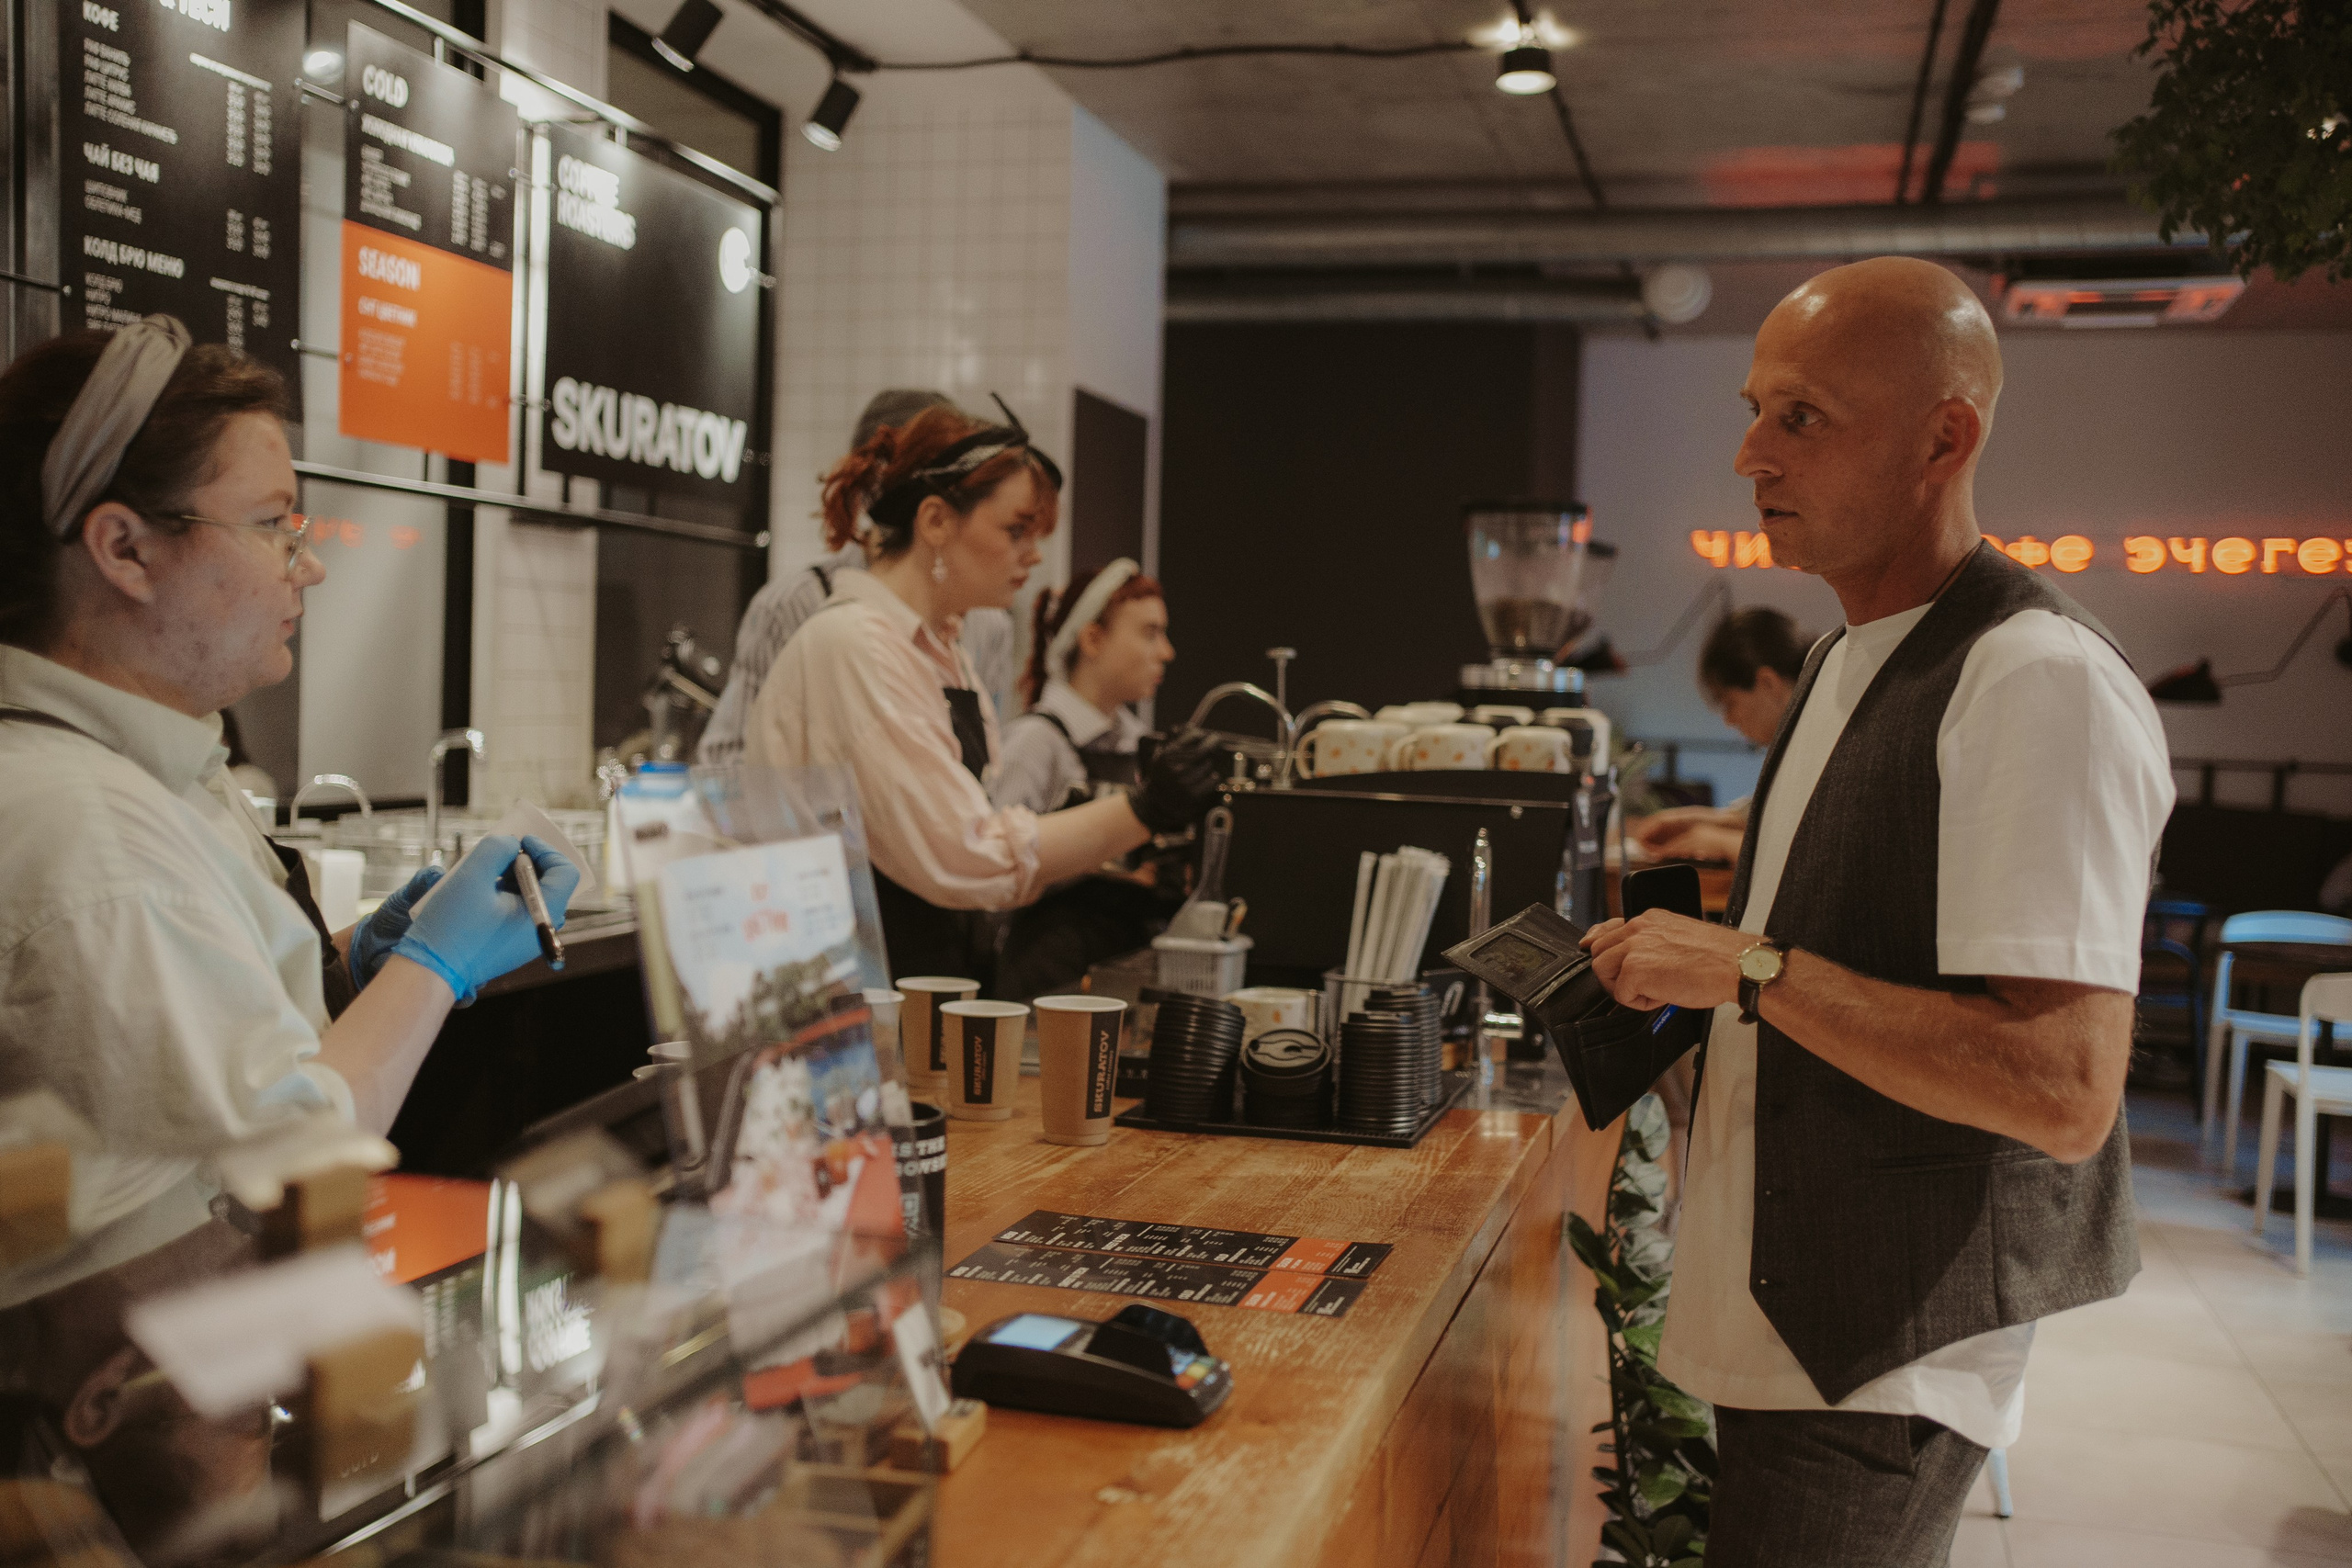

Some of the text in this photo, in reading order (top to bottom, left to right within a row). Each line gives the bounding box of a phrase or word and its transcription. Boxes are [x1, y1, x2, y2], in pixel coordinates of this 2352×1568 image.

[363, 64, 409, 108] COLD
[358, 245, 421, 292] SEASON
[551, 376, 747, 483] SKURATOV
[2124, 536, 2352, 574] эчеге
[1093, 1030, 1110, 1112] SKURATOV
